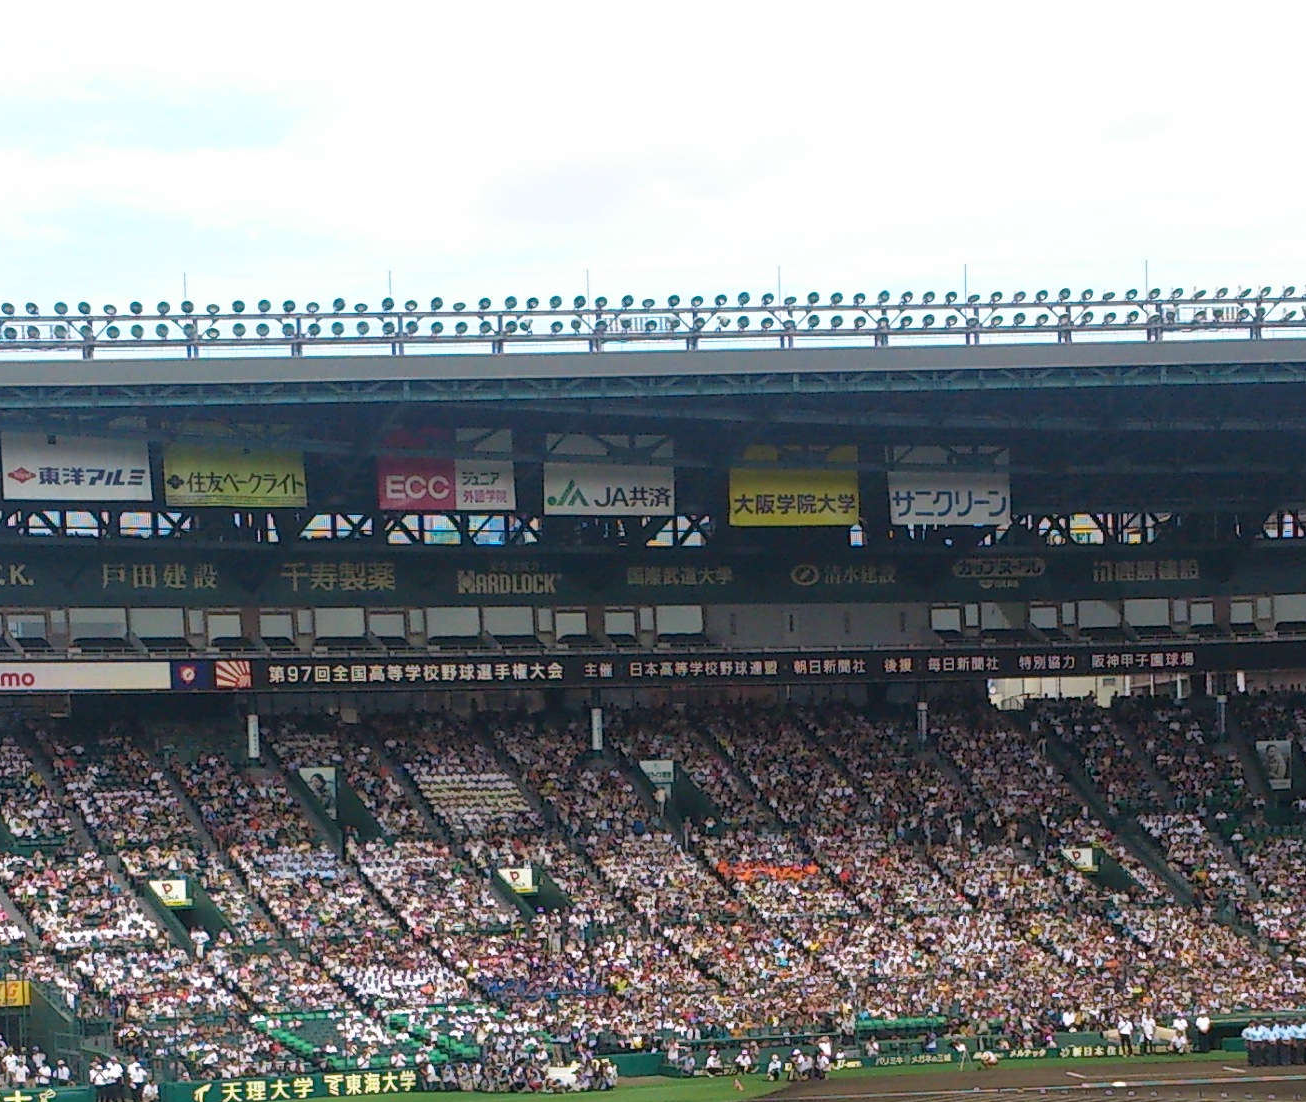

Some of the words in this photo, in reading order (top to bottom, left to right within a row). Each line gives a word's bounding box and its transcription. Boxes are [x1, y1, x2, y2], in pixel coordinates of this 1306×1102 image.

[38, 466, 146, 487] 東洋アルミ
[186, 470, 304, 495] 住友ベークライト
[384, 475, 451, 501] ECC
[462, 470, 501, 486] ジュニア
[594, 486, 671, 509] JA共済
[734, 493, 856, 516] 大阪学院大学
[892, 490, 1008, 518] サニクリーン
[101, 562, 218, 590] 戸田建設
[281, 561, 396, 592] 千寿製薬
[267, 662, 565, 684] 第97回全国高等学校野球選手権大会
[346, 1069, 417, 1096] 東海大学
